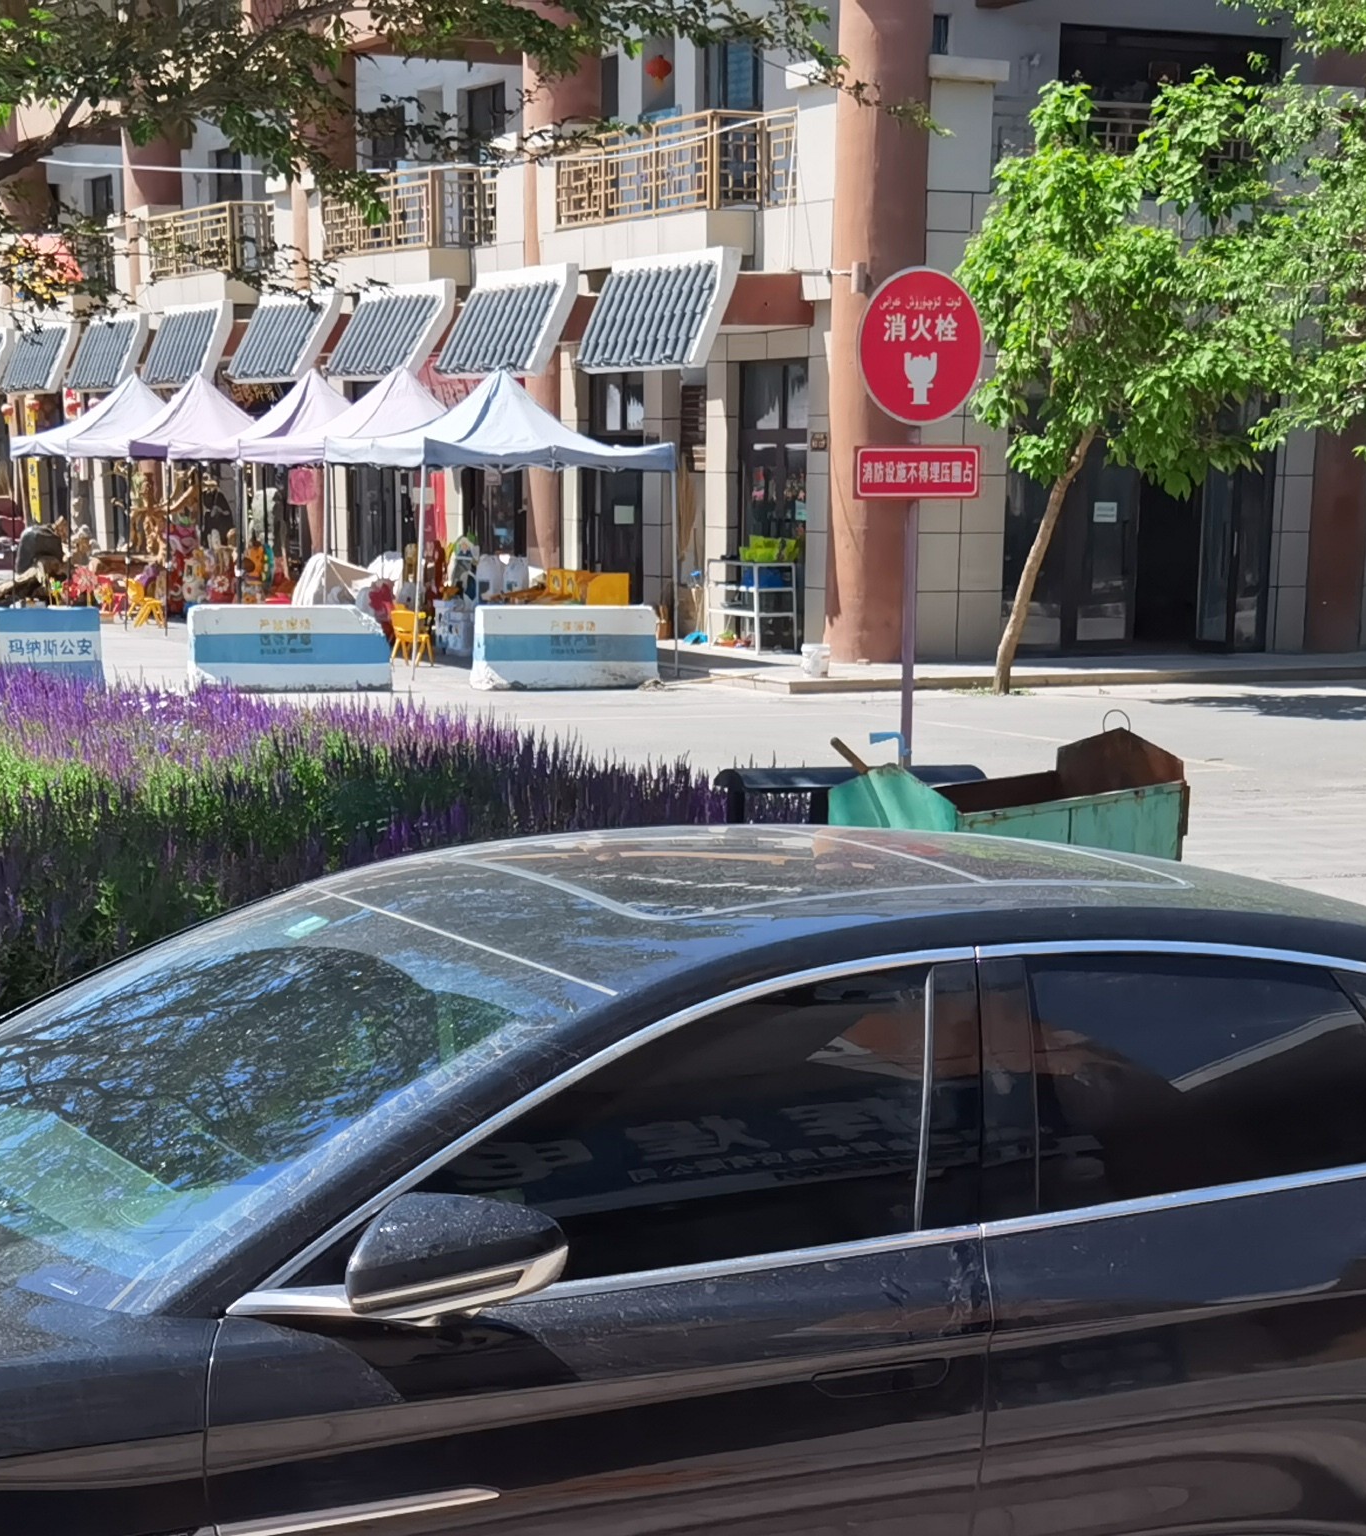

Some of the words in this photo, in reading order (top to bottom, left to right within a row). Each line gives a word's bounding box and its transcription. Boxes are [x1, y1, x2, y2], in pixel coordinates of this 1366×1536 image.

[883, 312, 959, 342] 消火栓
[8, 637, 94, 657] 玛纳斯公安
